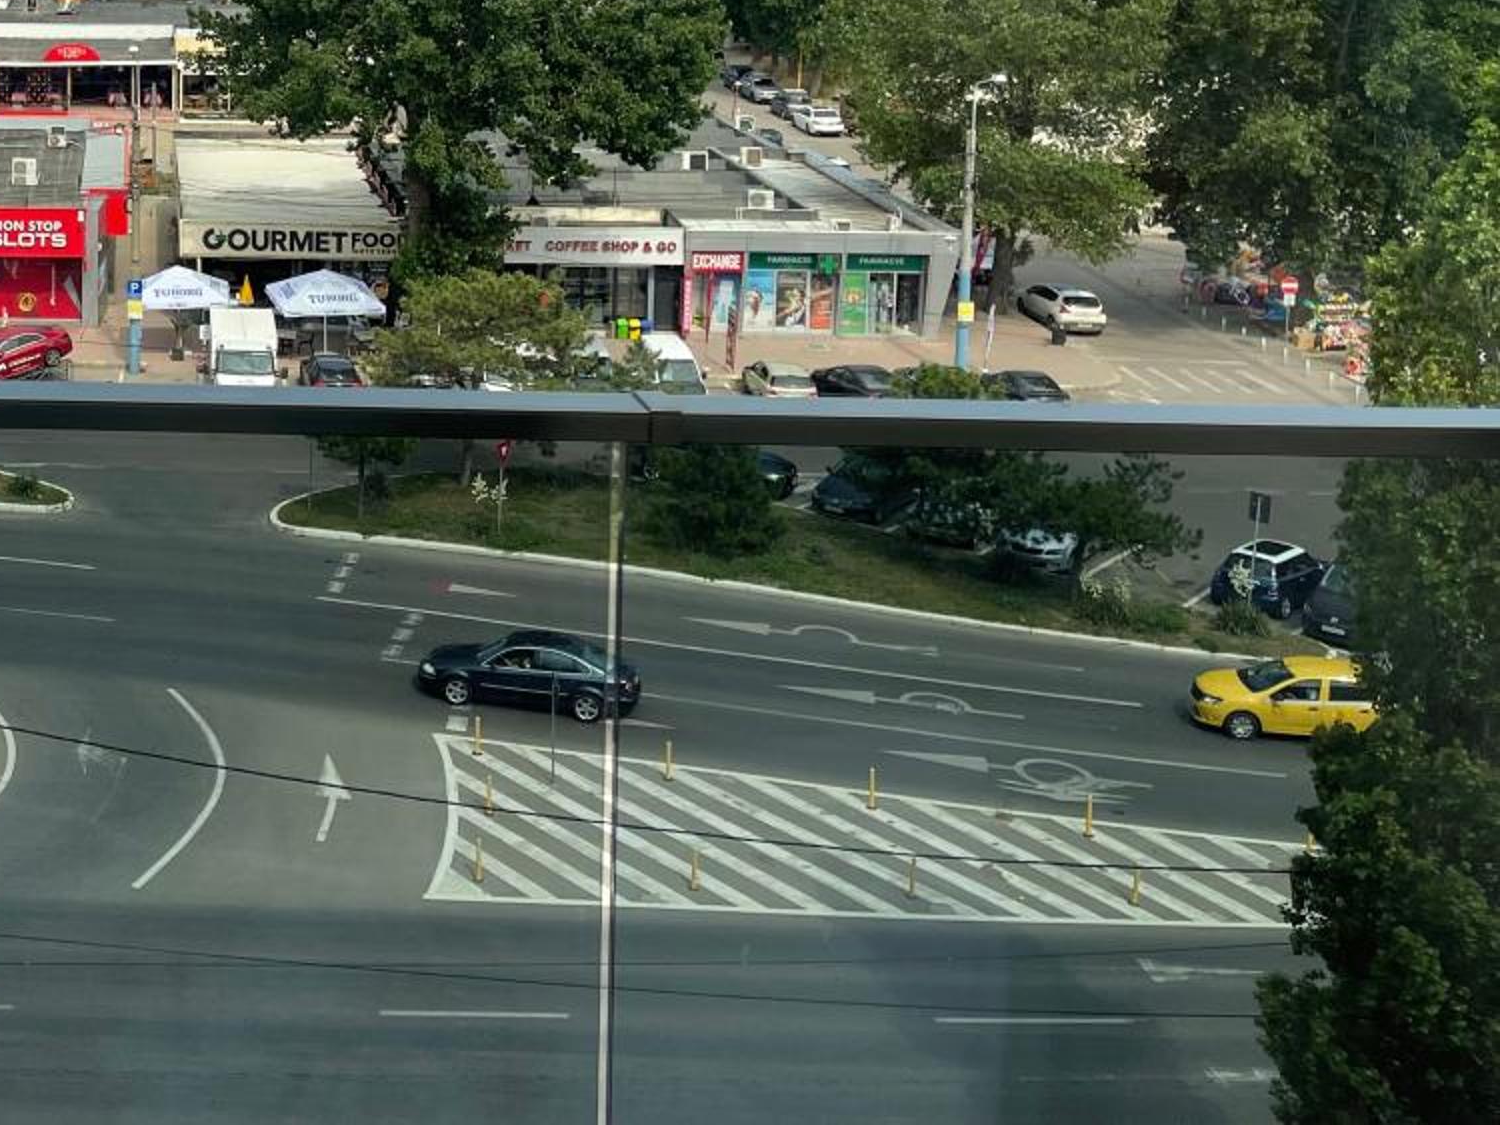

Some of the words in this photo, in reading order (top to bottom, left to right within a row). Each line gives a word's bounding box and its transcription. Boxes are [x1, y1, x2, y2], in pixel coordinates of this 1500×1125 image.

[28, 220, 63, 232] STOP
[202, 227, 349, 253] GOURMET
[351, 231, 402, 249] FOO
[545, 240, 598, 253] COFFEE
[602, 240, 639, 253] SHOP
[642, 240, 653, 253] &
[656, 240, 677, 253] GO
[692, 254, 741, 270] EXCHANGE
